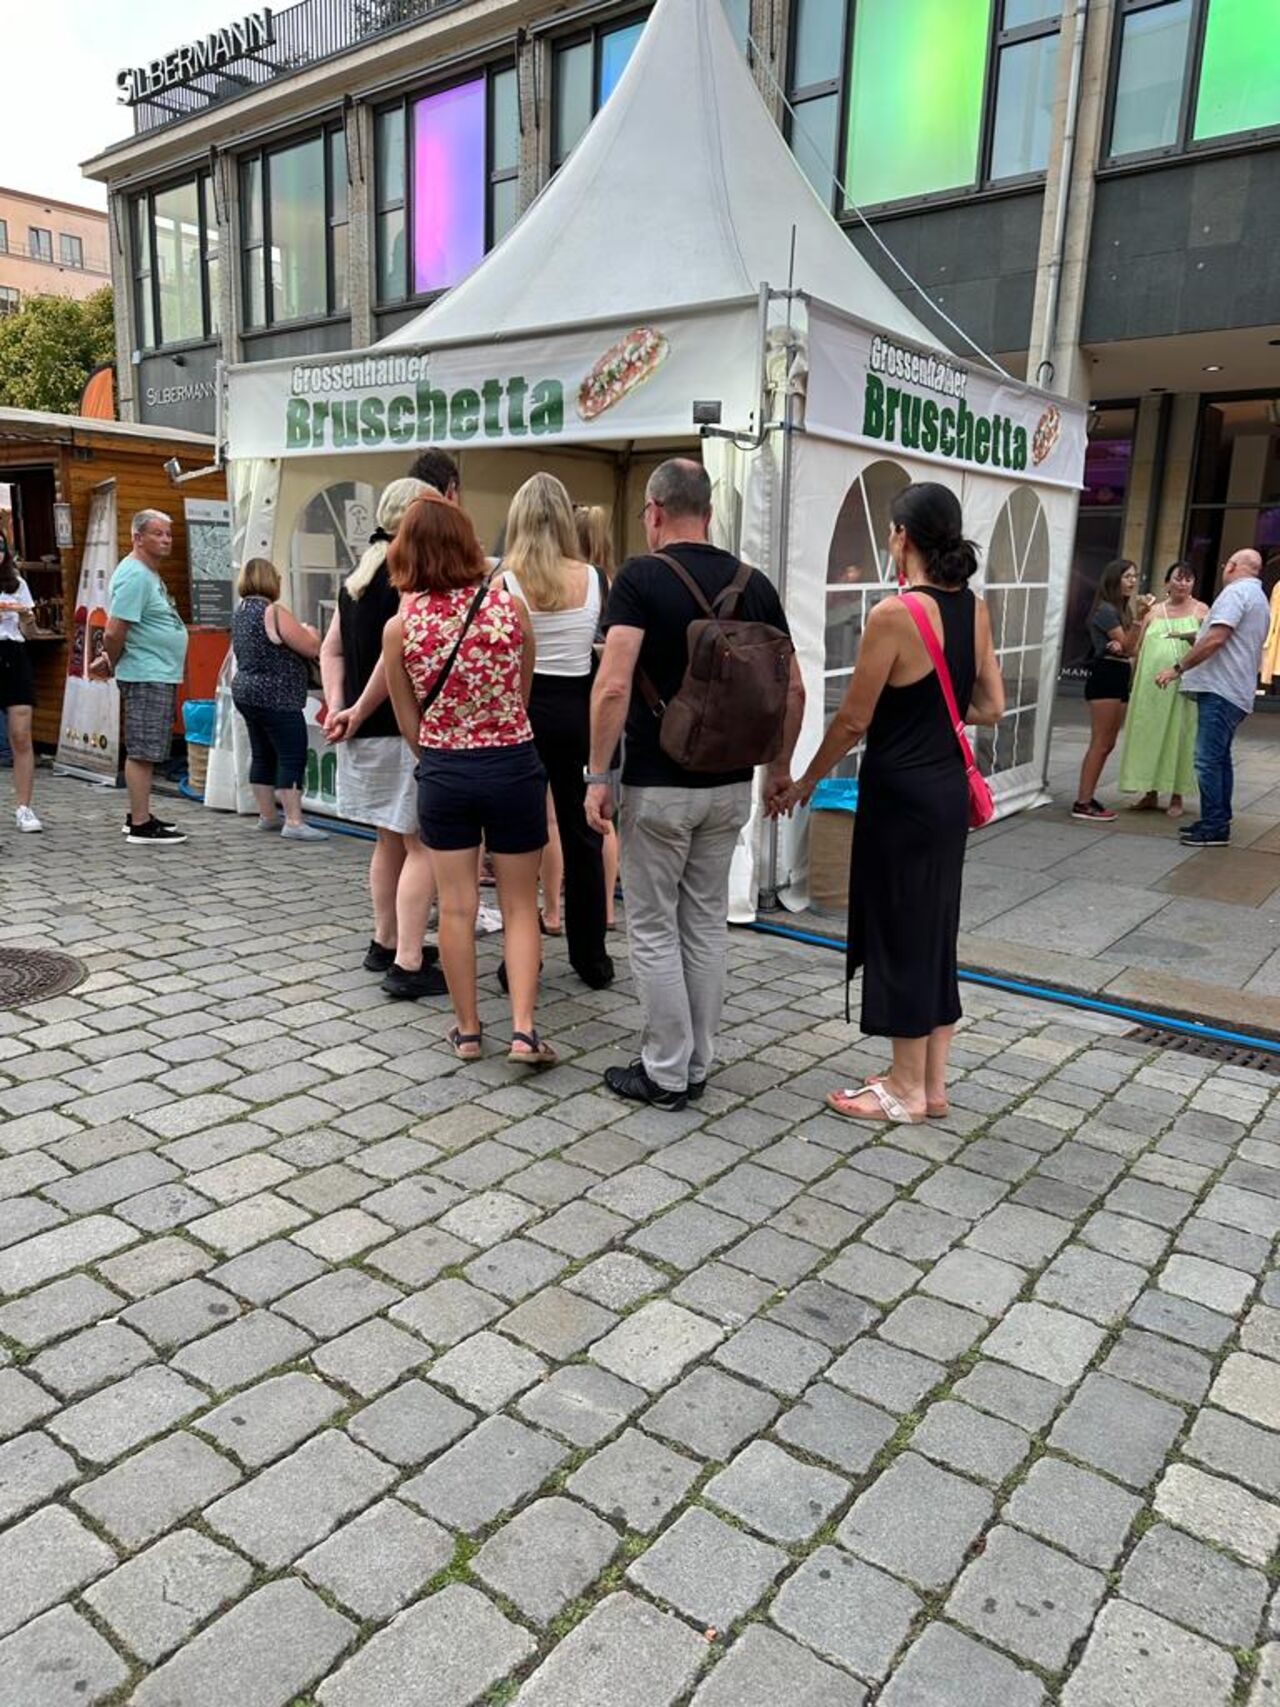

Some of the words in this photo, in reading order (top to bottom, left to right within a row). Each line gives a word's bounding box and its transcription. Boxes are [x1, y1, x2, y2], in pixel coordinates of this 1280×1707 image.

[116, 7, 273, 106] SILBERMANN
[292, 353, 429, 395] Grossenhainer
[870, 335, 969, 399] Grossenhainer
[286, 376, 564, 449] Bruschetta
[863, 373, 1028, 471] Bruschetta
